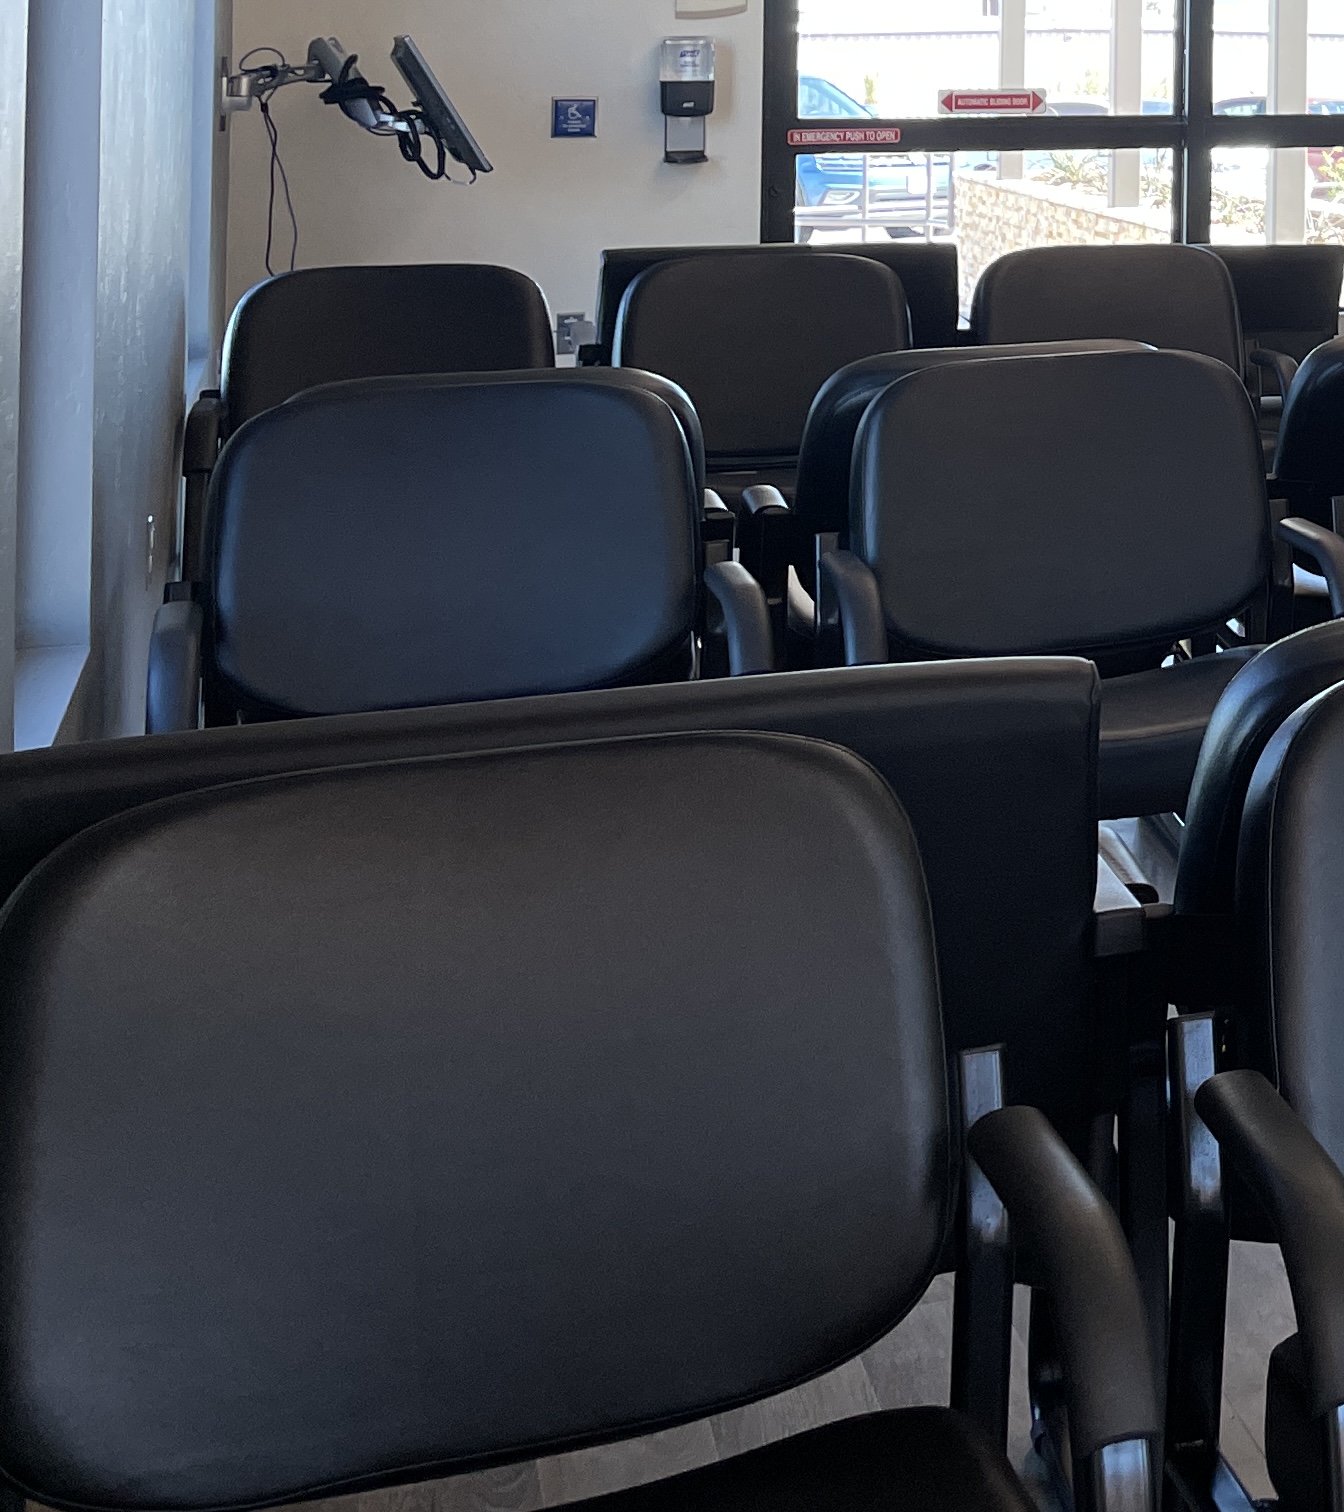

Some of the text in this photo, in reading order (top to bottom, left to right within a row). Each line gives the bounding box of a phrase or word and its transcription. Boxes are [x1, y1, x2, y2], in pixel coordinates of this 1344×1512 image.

[793, 130, 896, 143] IN EMERGENCY PUSH TO OPEN
